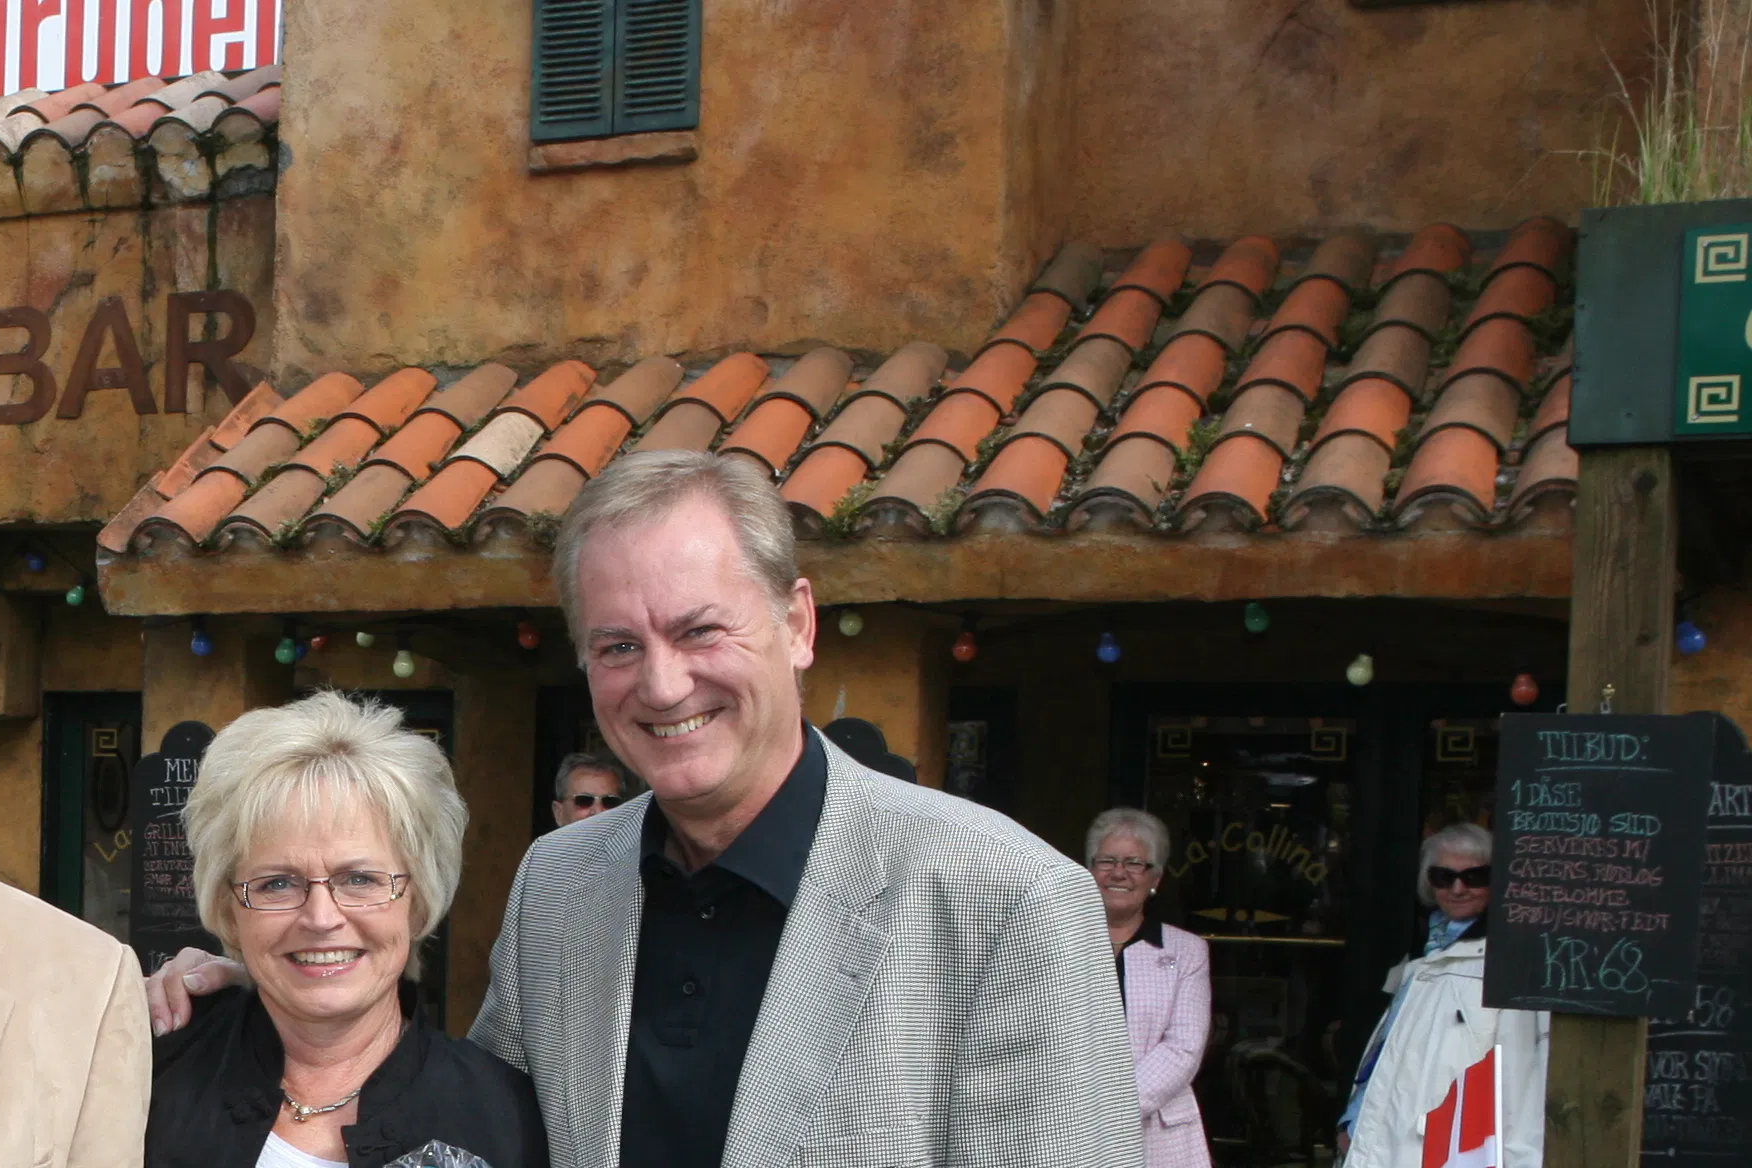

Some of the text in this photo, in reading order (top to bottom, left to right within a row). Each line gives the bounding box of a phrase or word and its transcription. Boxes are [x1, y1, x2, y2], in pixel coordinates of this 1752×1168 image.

[1536, 730, 1650, 763] TILBUD:
[1510, 779, 1522, 806] 1
[1609, 812, 1663, 837] SILD
[1221, 821, 1330, 887] Collina
